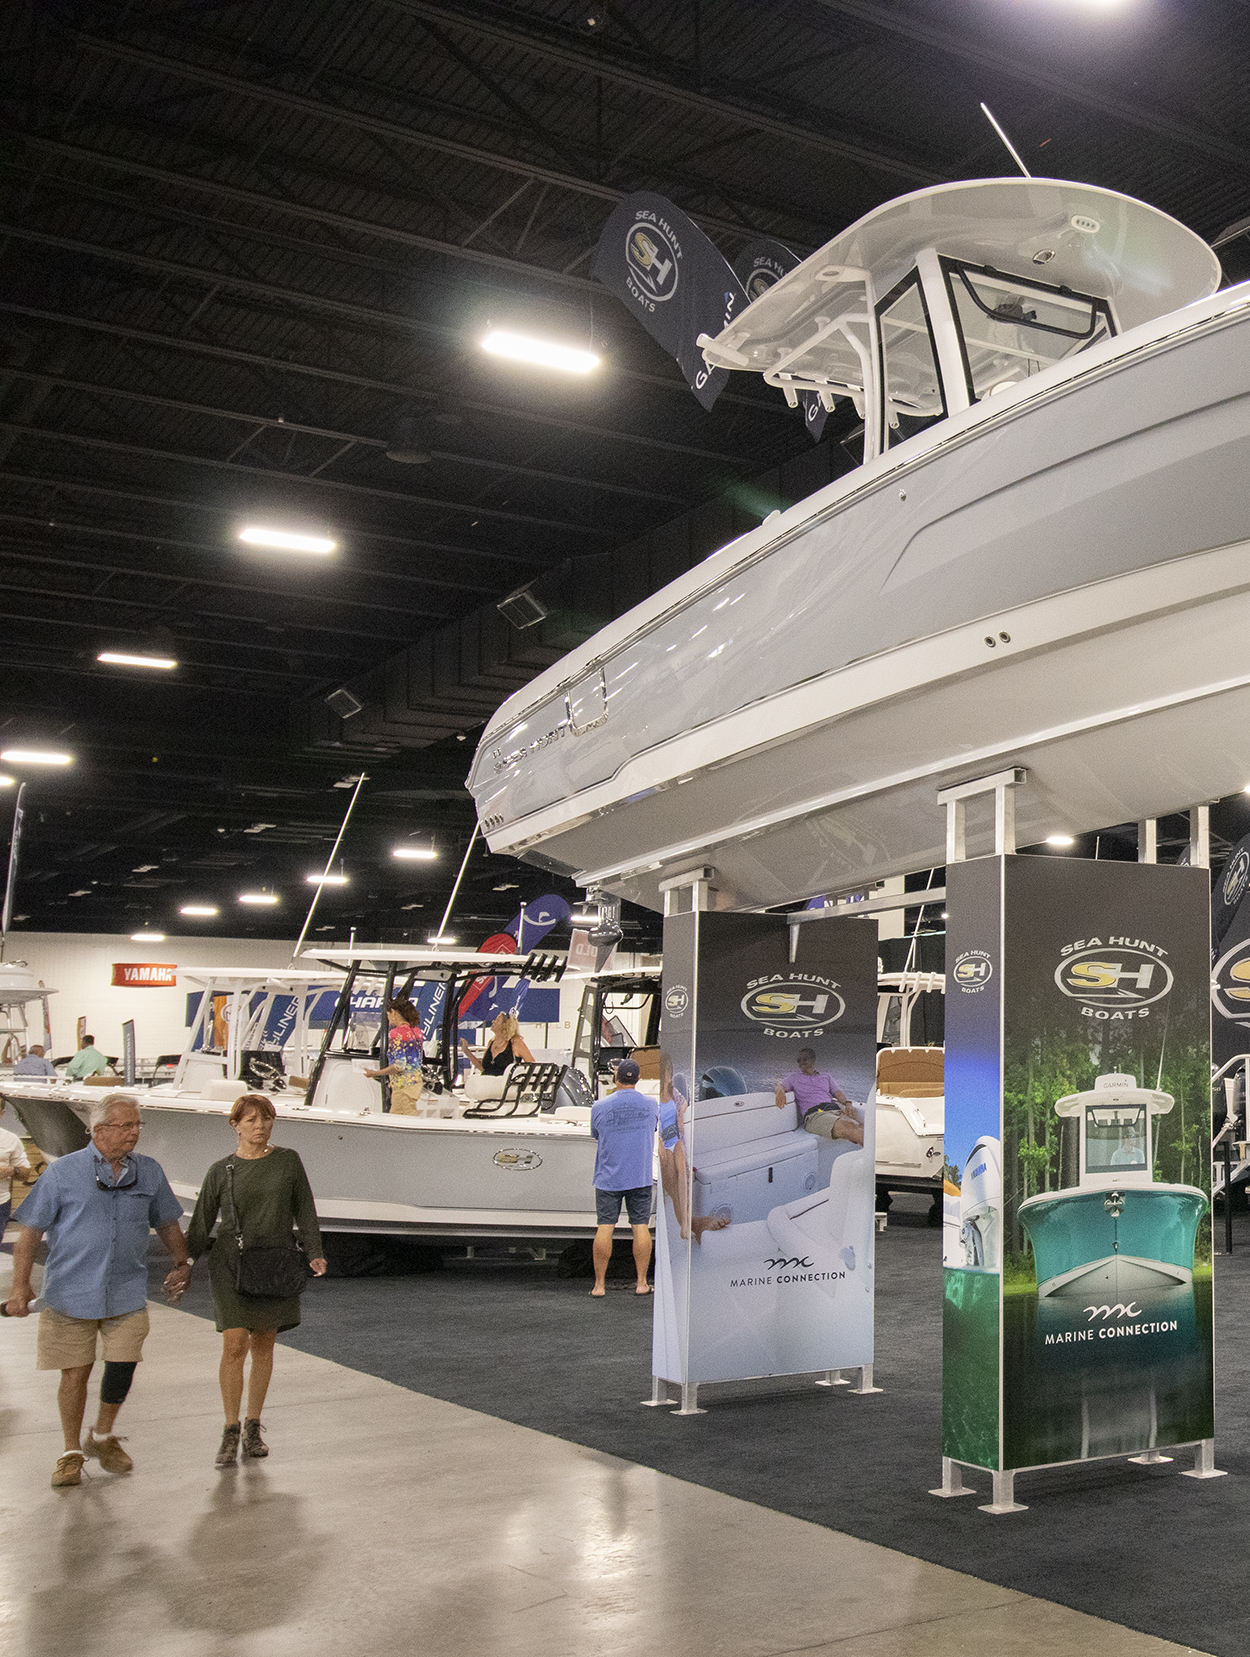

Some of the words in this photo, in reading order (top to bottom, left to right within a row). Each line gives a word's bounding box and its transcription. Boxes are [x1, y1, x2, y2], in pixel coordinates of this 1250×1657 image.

[635, 210, 657, 223] SEA
[658, 218, 683, 260] HUNT
[631, 232, 673, 286] SH
[753, 256, 772, 269] SEA
[625, 276, 656, 313] BOATS
[1060, 937, 1103, 957] SEA
[1108, 936, 1168, 957] HUNT
[955, 952, 970, 964] SEA
[970, 950, 991, 959] HUNT
[124, 967, 172, 981] YAMAHA
[957, 962, 987, 978] SH
[1066, 961, 1155, 989] SH
[746, 974, 784, 989] SEA
[788, 973, 842, 989] HUNT
[961, 985, 985, 994] BOATS
[751, 992, 830, 1014] SH
[1080, 1007, 1150, 1020] BOATS
[763, 1028, 824, 1039] BOATS
[730, 1276, 772, 1287] MARINE
[776, 1271, 846, 1284] CONNECTION
[1044, 1329, 1094, 1345] MARINE
[1098, 1320, 1178, 1339] CONNECTION
